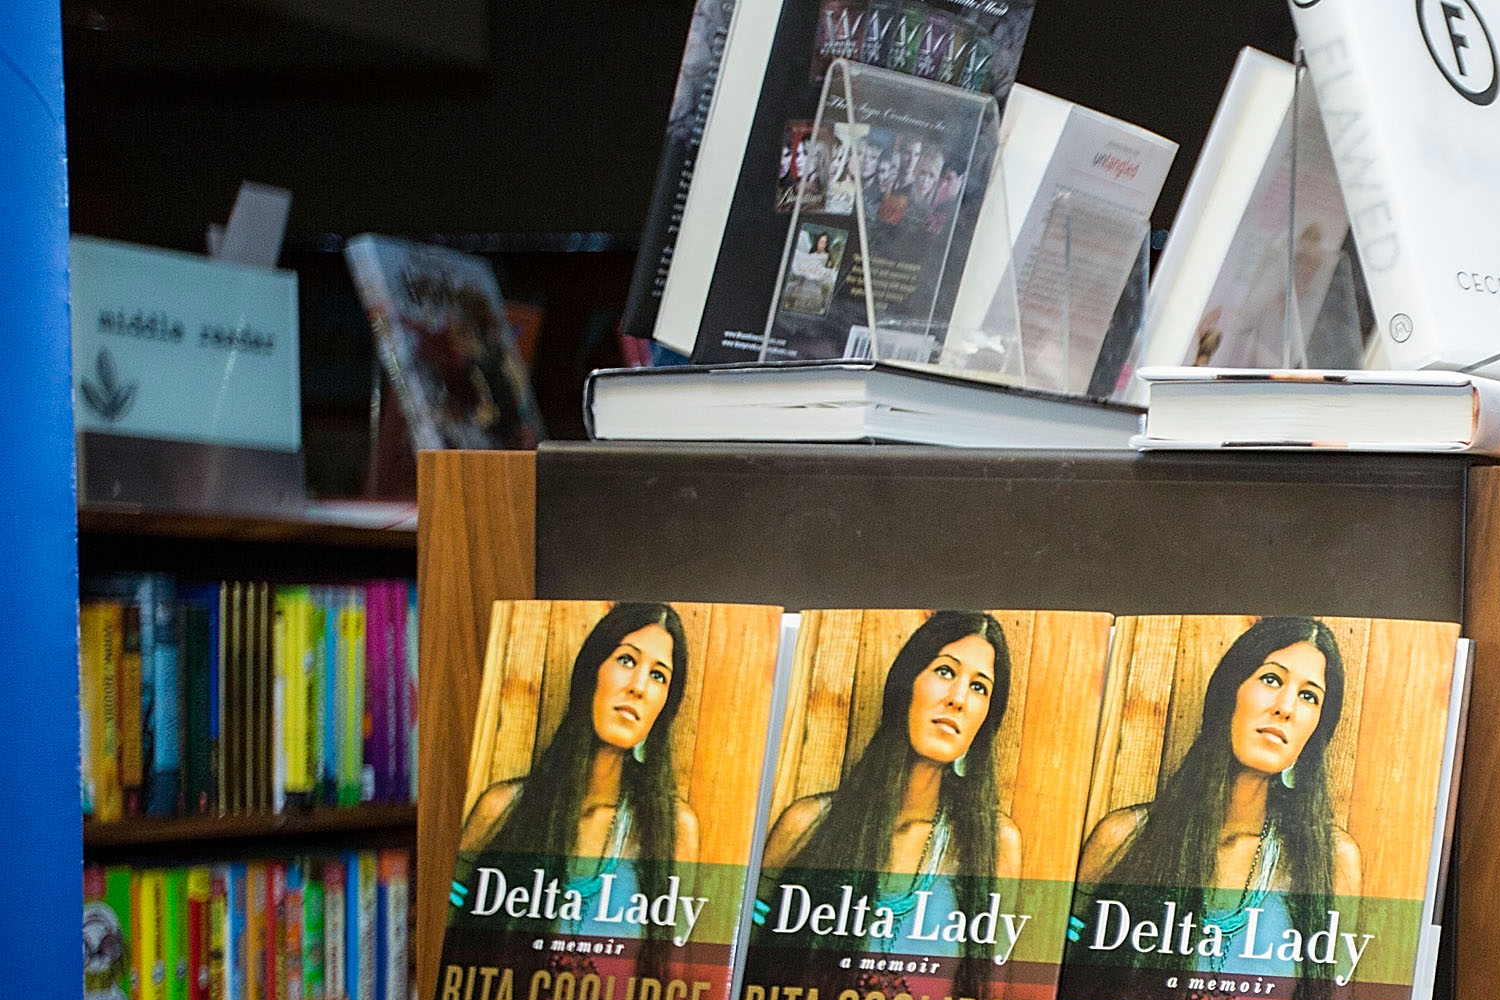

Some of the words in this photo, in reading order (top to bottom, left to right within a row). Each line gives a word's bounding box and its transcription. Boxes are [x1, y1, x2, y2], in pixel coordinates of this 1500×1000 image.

[1093, 151, 1140, 180] untangled
[98, 308, 184, 343] middle
[199, 322, 275, 356] reader
[470, 867, 582, 921] Delta
[592, 873, 709, 947] Lady
[772, 884, 894, 939] Delta
[907, 890, 1032, 965] Lady
[532, 938, 544, 951] a
[550, 938, 625, 955] memoir
[1088, 899, 1224, 958] Delta
[1238, 907, 1375, 986] Lady
[839, 957, 851, 969] a
[859, 957, 941, 974] memoir
[1167, 977, 1178, 989] a
[1188, 976, 1276, 995] memoir
